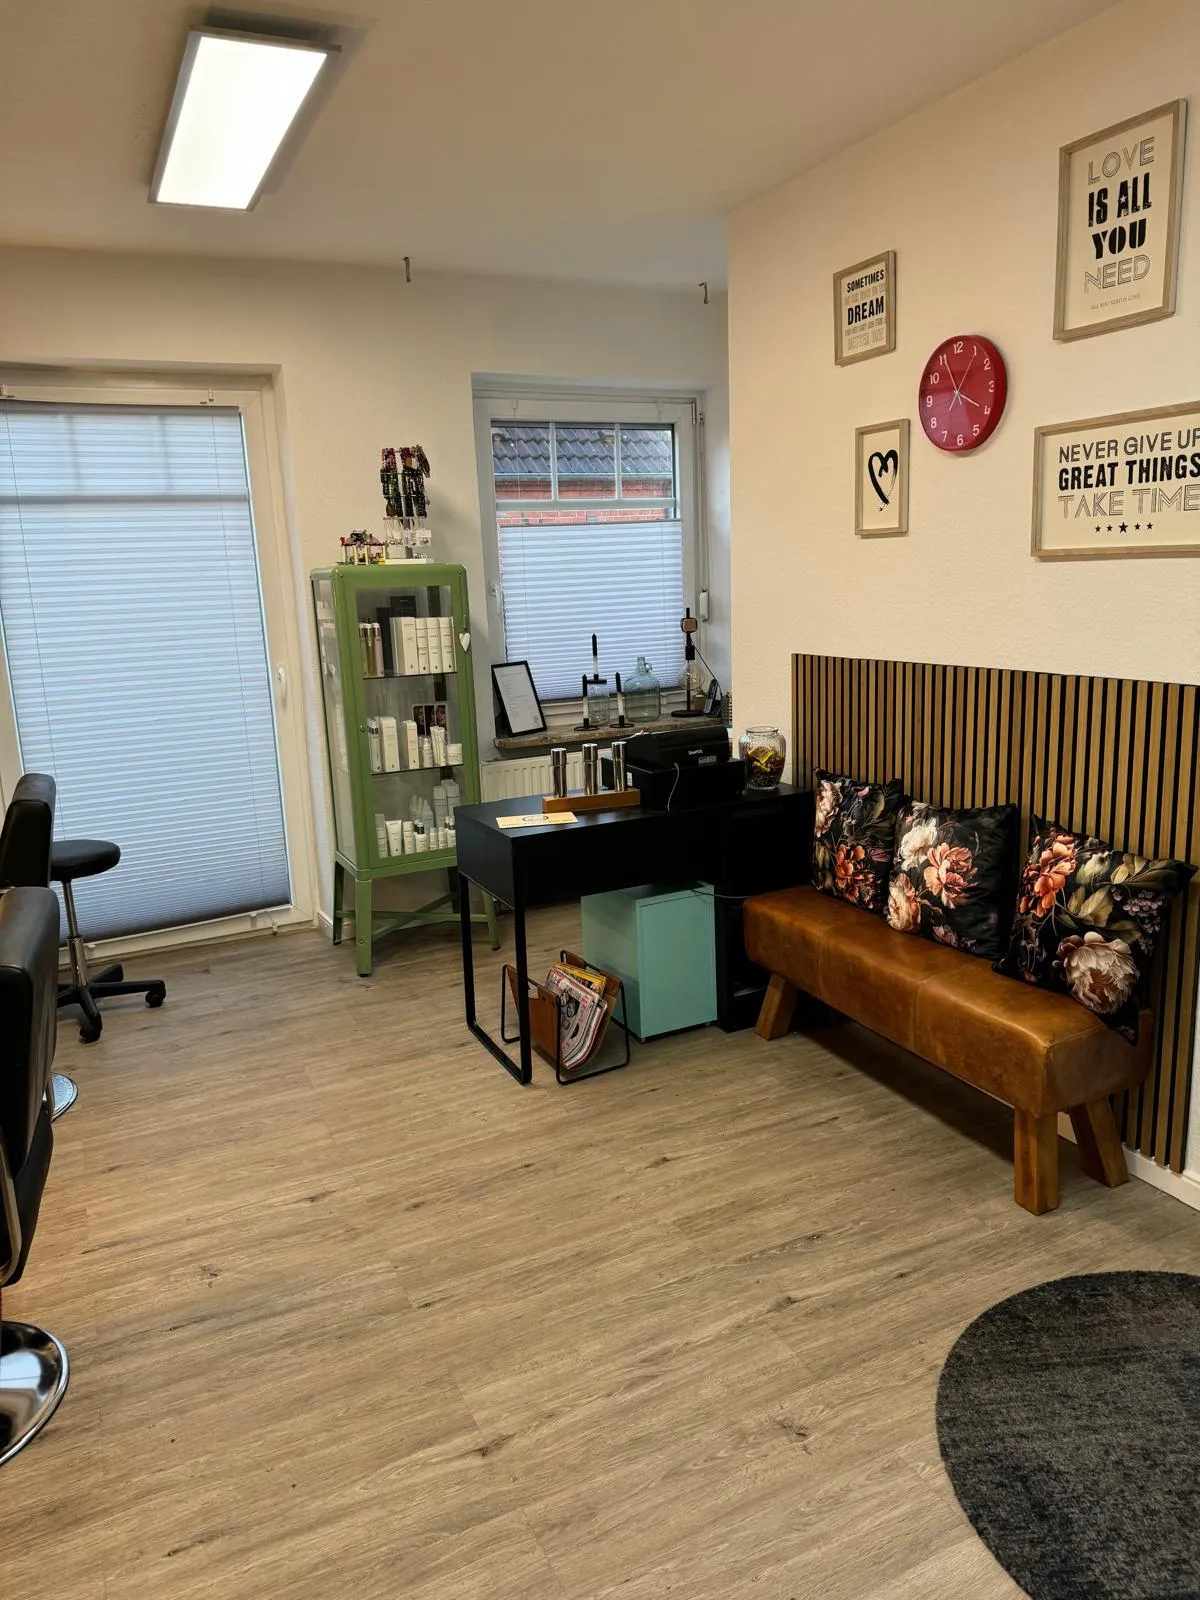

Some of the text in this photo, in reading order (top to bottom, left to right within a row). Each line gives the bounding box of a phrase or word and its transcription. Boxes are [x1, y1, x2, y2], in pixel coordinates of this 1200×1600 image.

[1087, 136, 1155, 185] LOVE
[1088, 172, 1152, 227] IS ALL
[1092, 218, 1147, 259] YOU
[1084, 254, 1151, 293] NEED
[847, 269, 885, 293] SOMETIMES
[848, 296, 884, 325] DREAM
[953, 341, 963, 354] 12
[973, 345, 977, 356] 1
[983, 358, 991, 370] 2
[929, 372, 939, 384] 10
[988, 380, 995, 392] 3
[926, 395, 933, 407] 9
[984, 405, 991, 415] 4
[930, 417, 937, 428] 8
[942, 430, 948, 442] 7
[972, 424, 980, 436] 5
[956, 434, 964, 446] 6
[1059, 439, 1119, 463] NEVER
[1123, 431, 1172, 456] GIVE
[1058, 453, 1200, 491] GREAT THINGS
[1058, 483, 1200, 519] TAKE TIME
